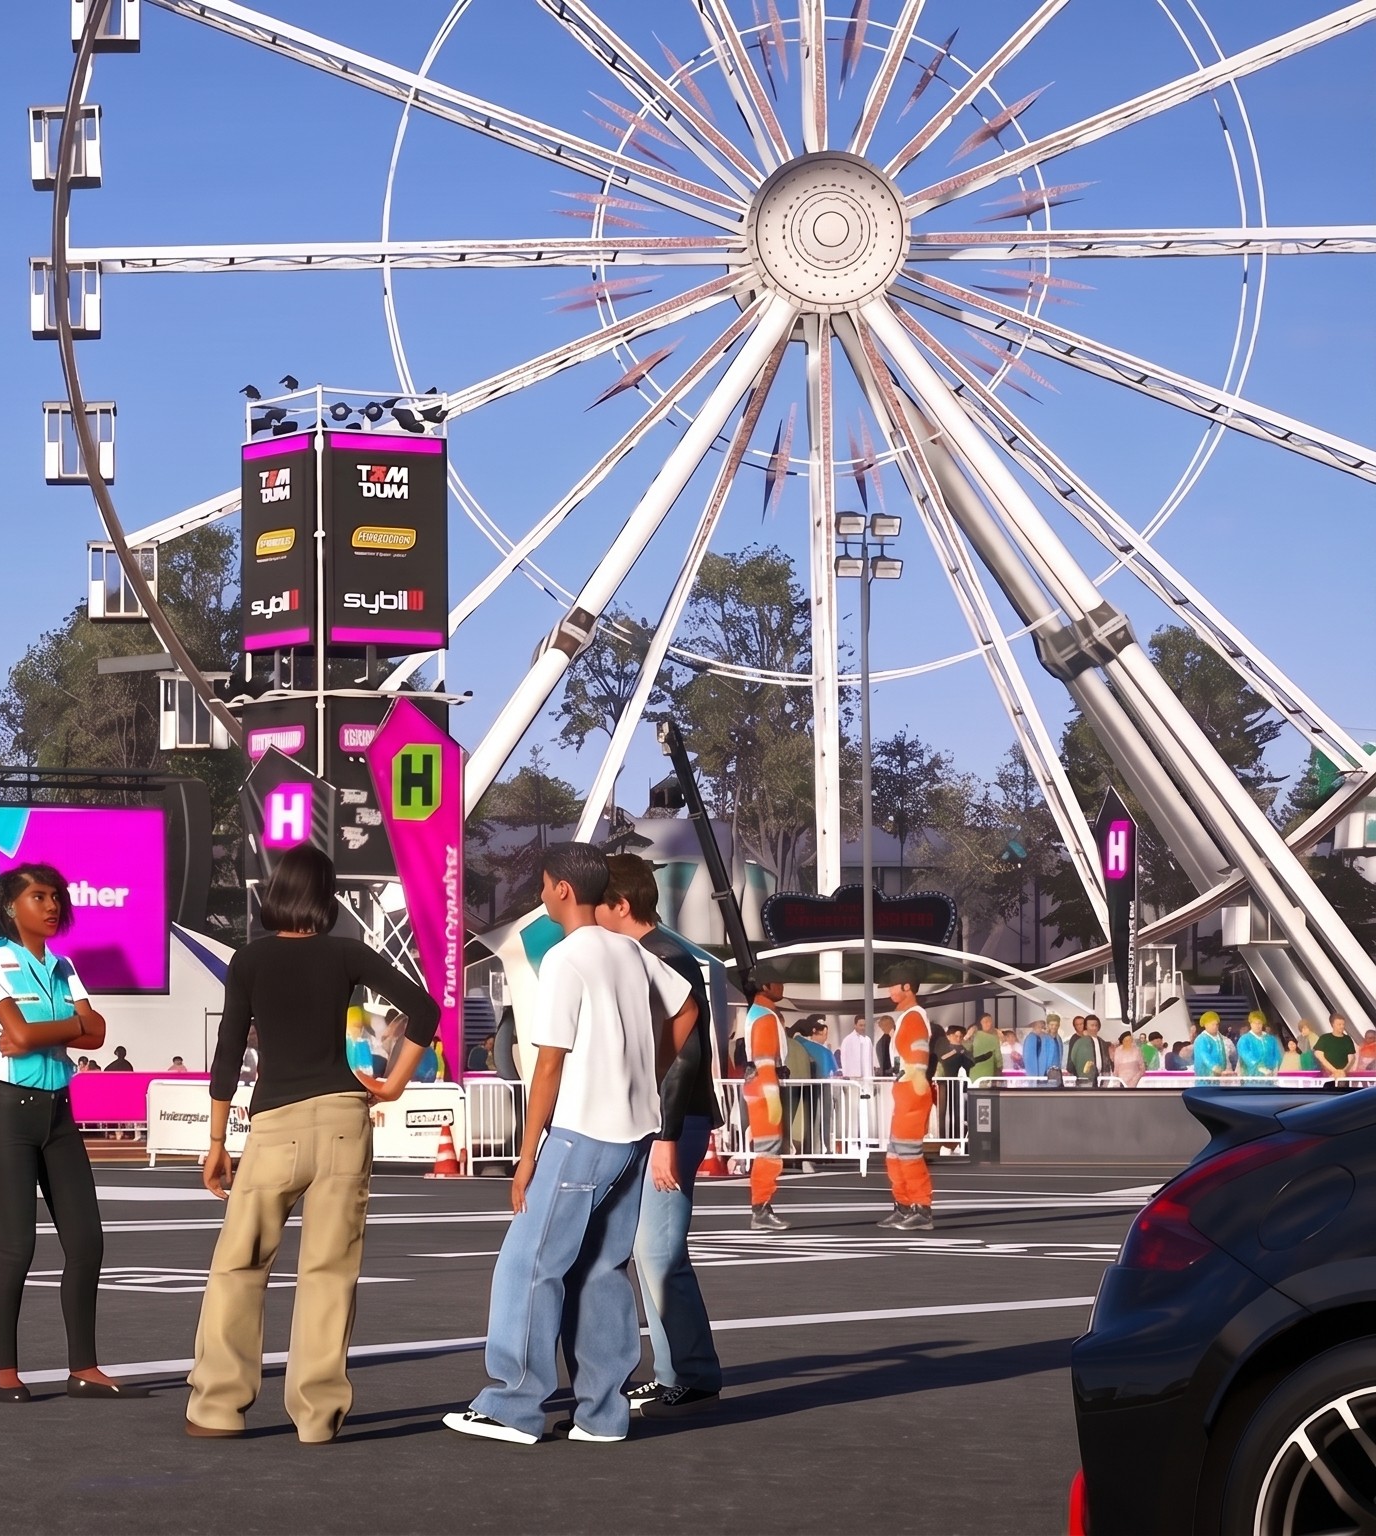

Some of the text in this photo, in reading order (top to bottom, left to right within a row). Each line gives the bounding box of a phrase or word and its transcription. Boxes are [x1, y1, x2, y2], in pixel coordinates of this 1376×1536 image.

[358, 482, 409, 500] DUM
[401, 754, 433, 806] H
[270, 793, 304, 841] H
[1108, 830, 1126, 872] H
